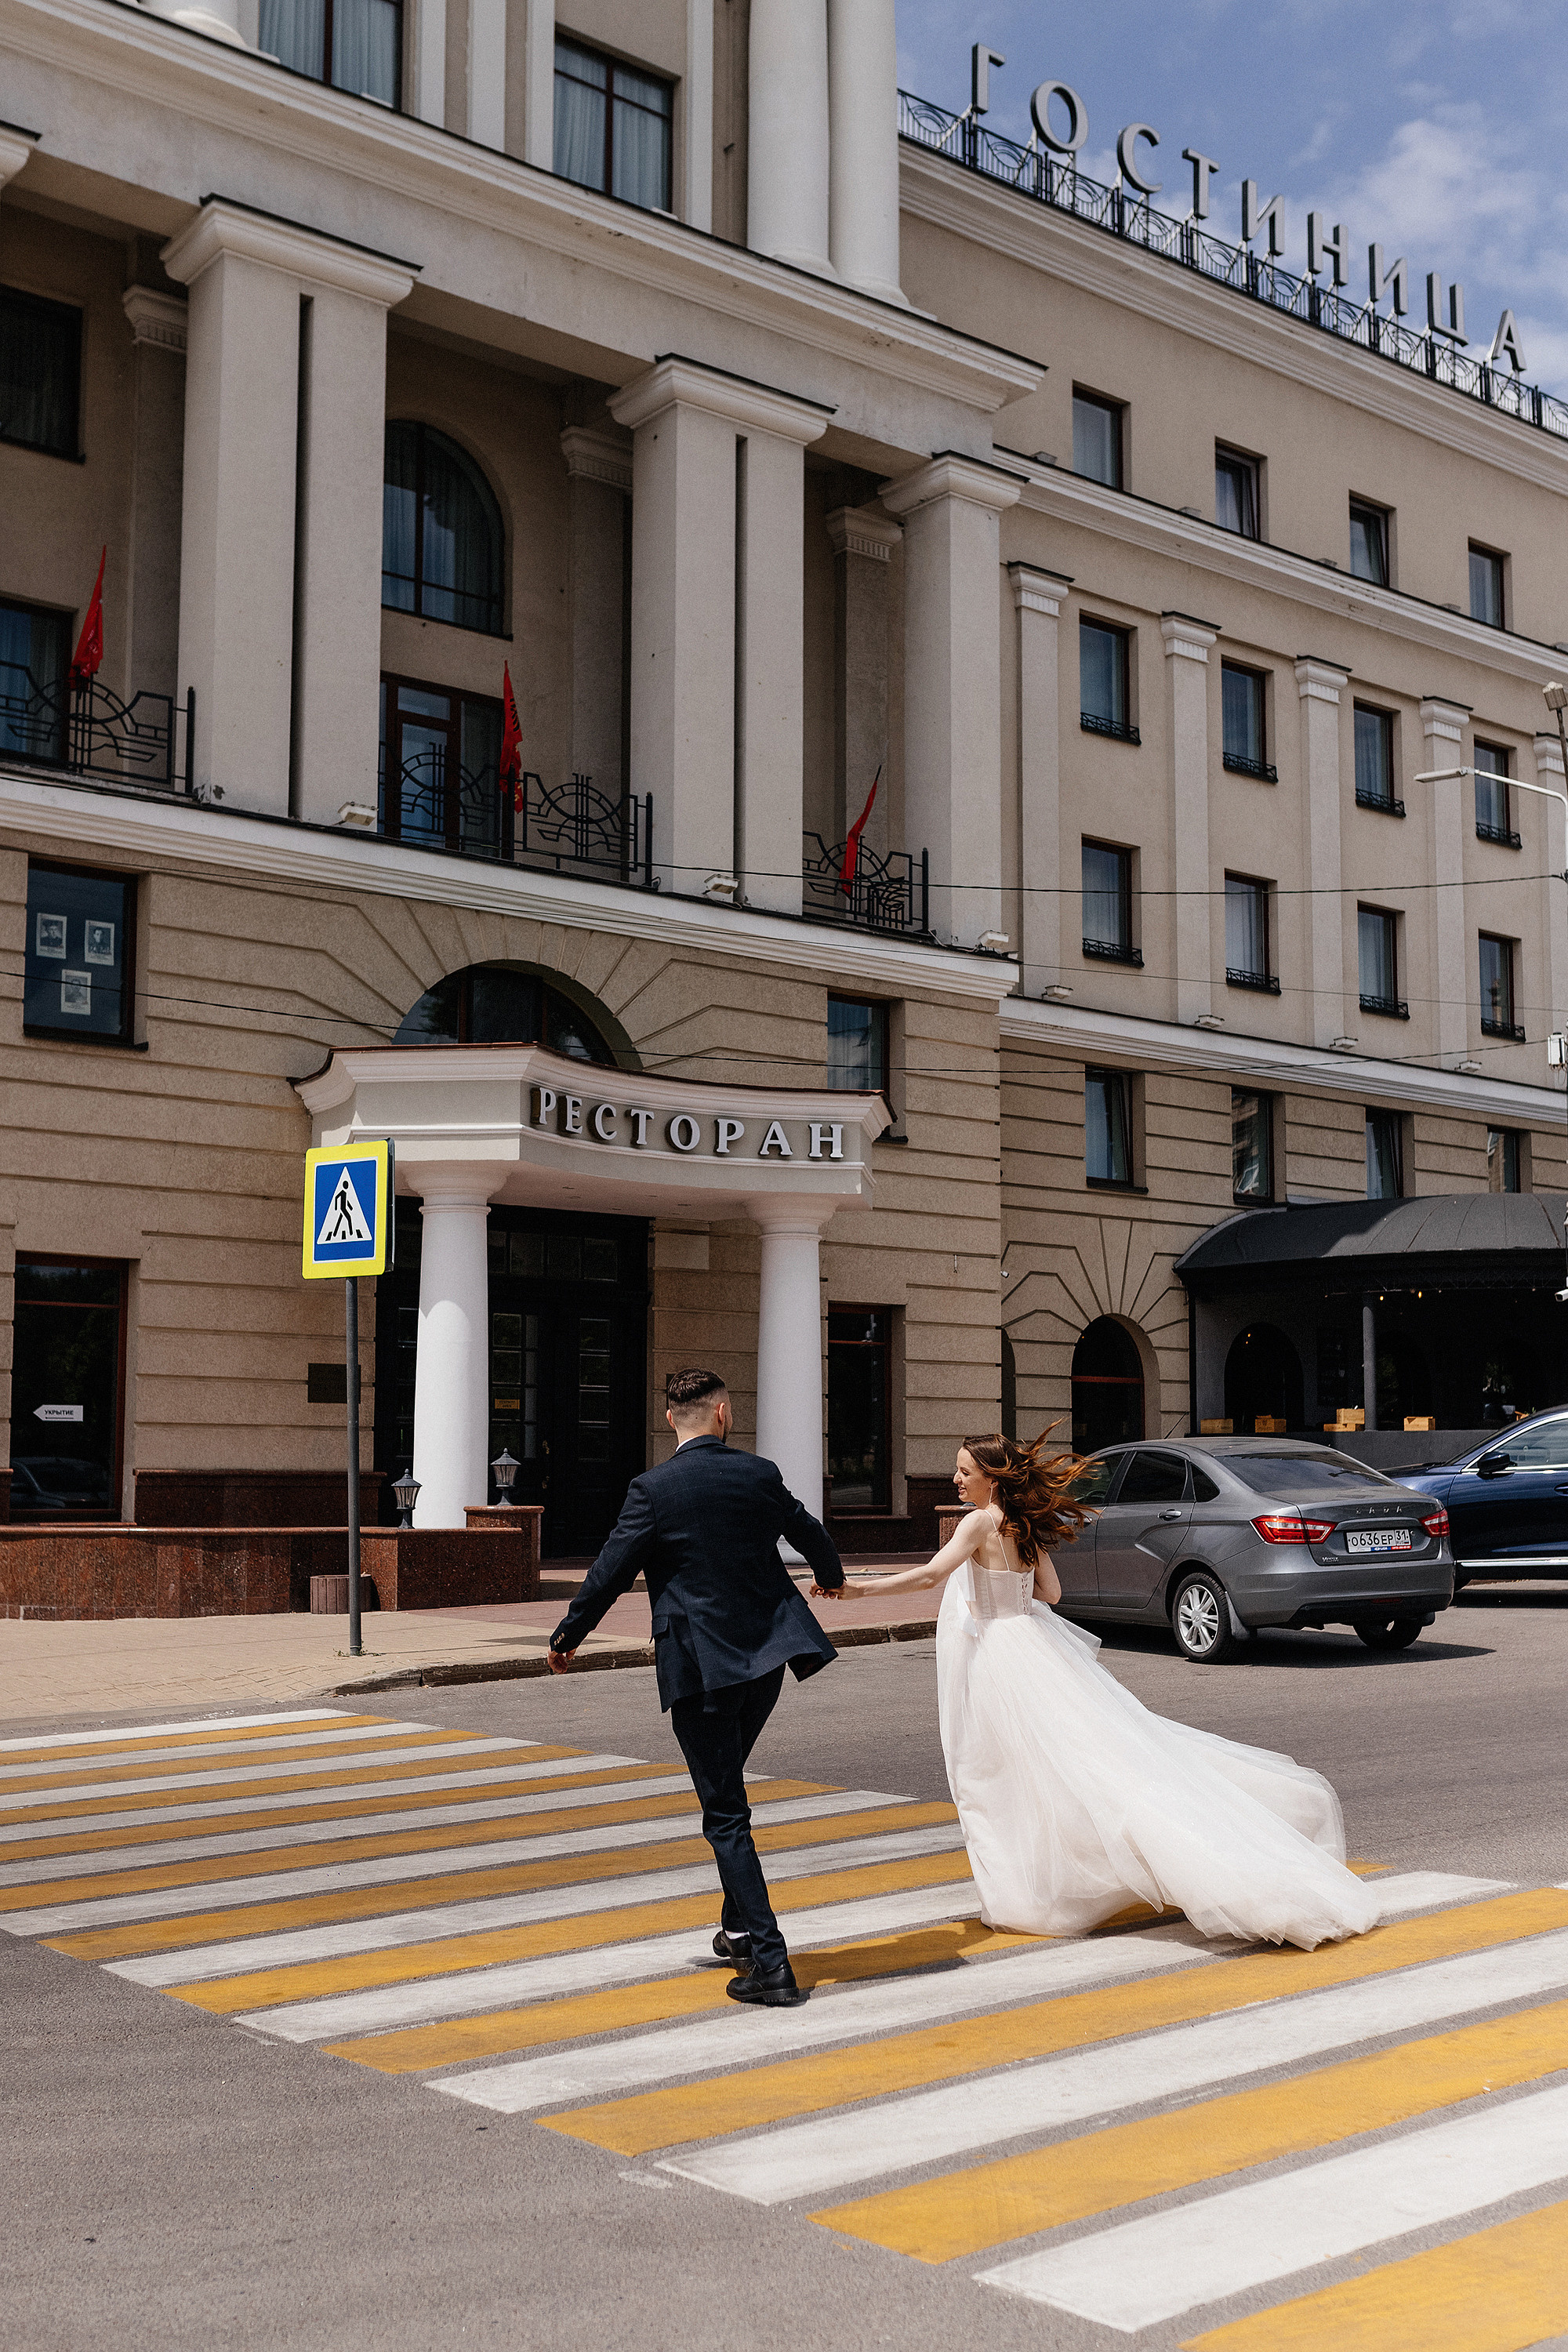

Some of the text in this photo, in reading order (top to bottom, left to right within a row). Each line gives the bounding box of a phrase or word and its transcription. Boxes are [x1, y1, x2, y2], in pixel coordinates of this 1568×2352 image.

[971, 42, 1527, 372] ГОСТИНИЦА
[532, 1087, 844, 1160] РЕСТОРАН
[1396, 1530, 1406, 1541] 31
